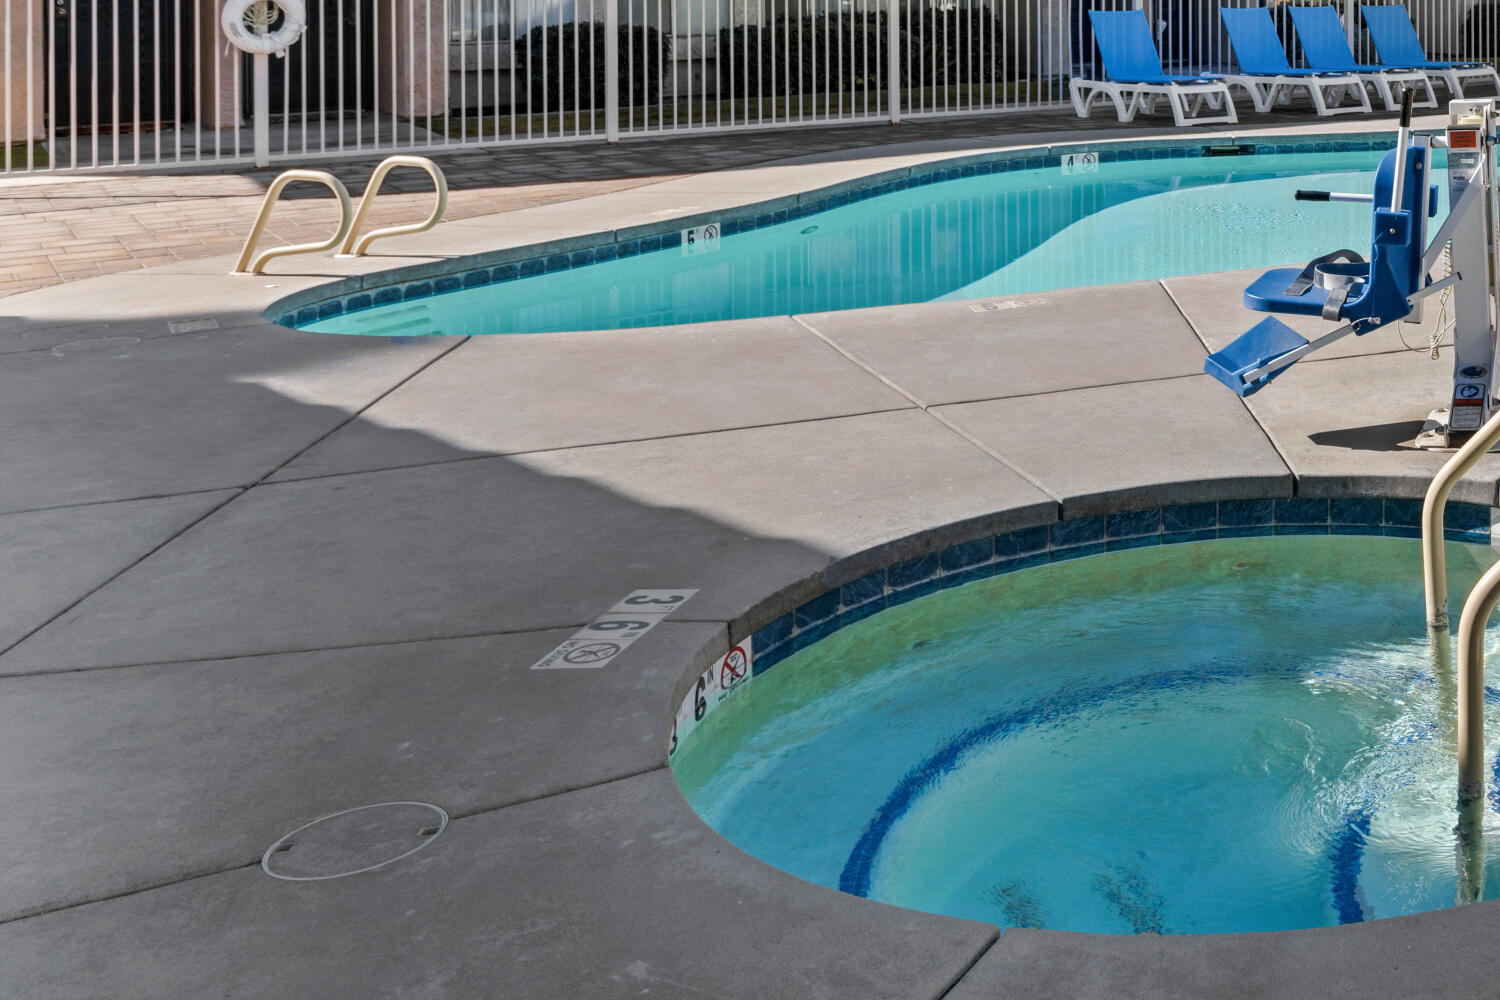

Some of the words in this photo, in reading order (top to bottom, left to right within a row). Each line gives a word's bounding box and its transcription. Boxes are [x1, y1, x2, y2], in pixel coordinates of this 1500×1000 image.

[624, 595, 684, 605] 3
[588, 620, 650, 632] 6
[694, 676, 707, 722] 6
